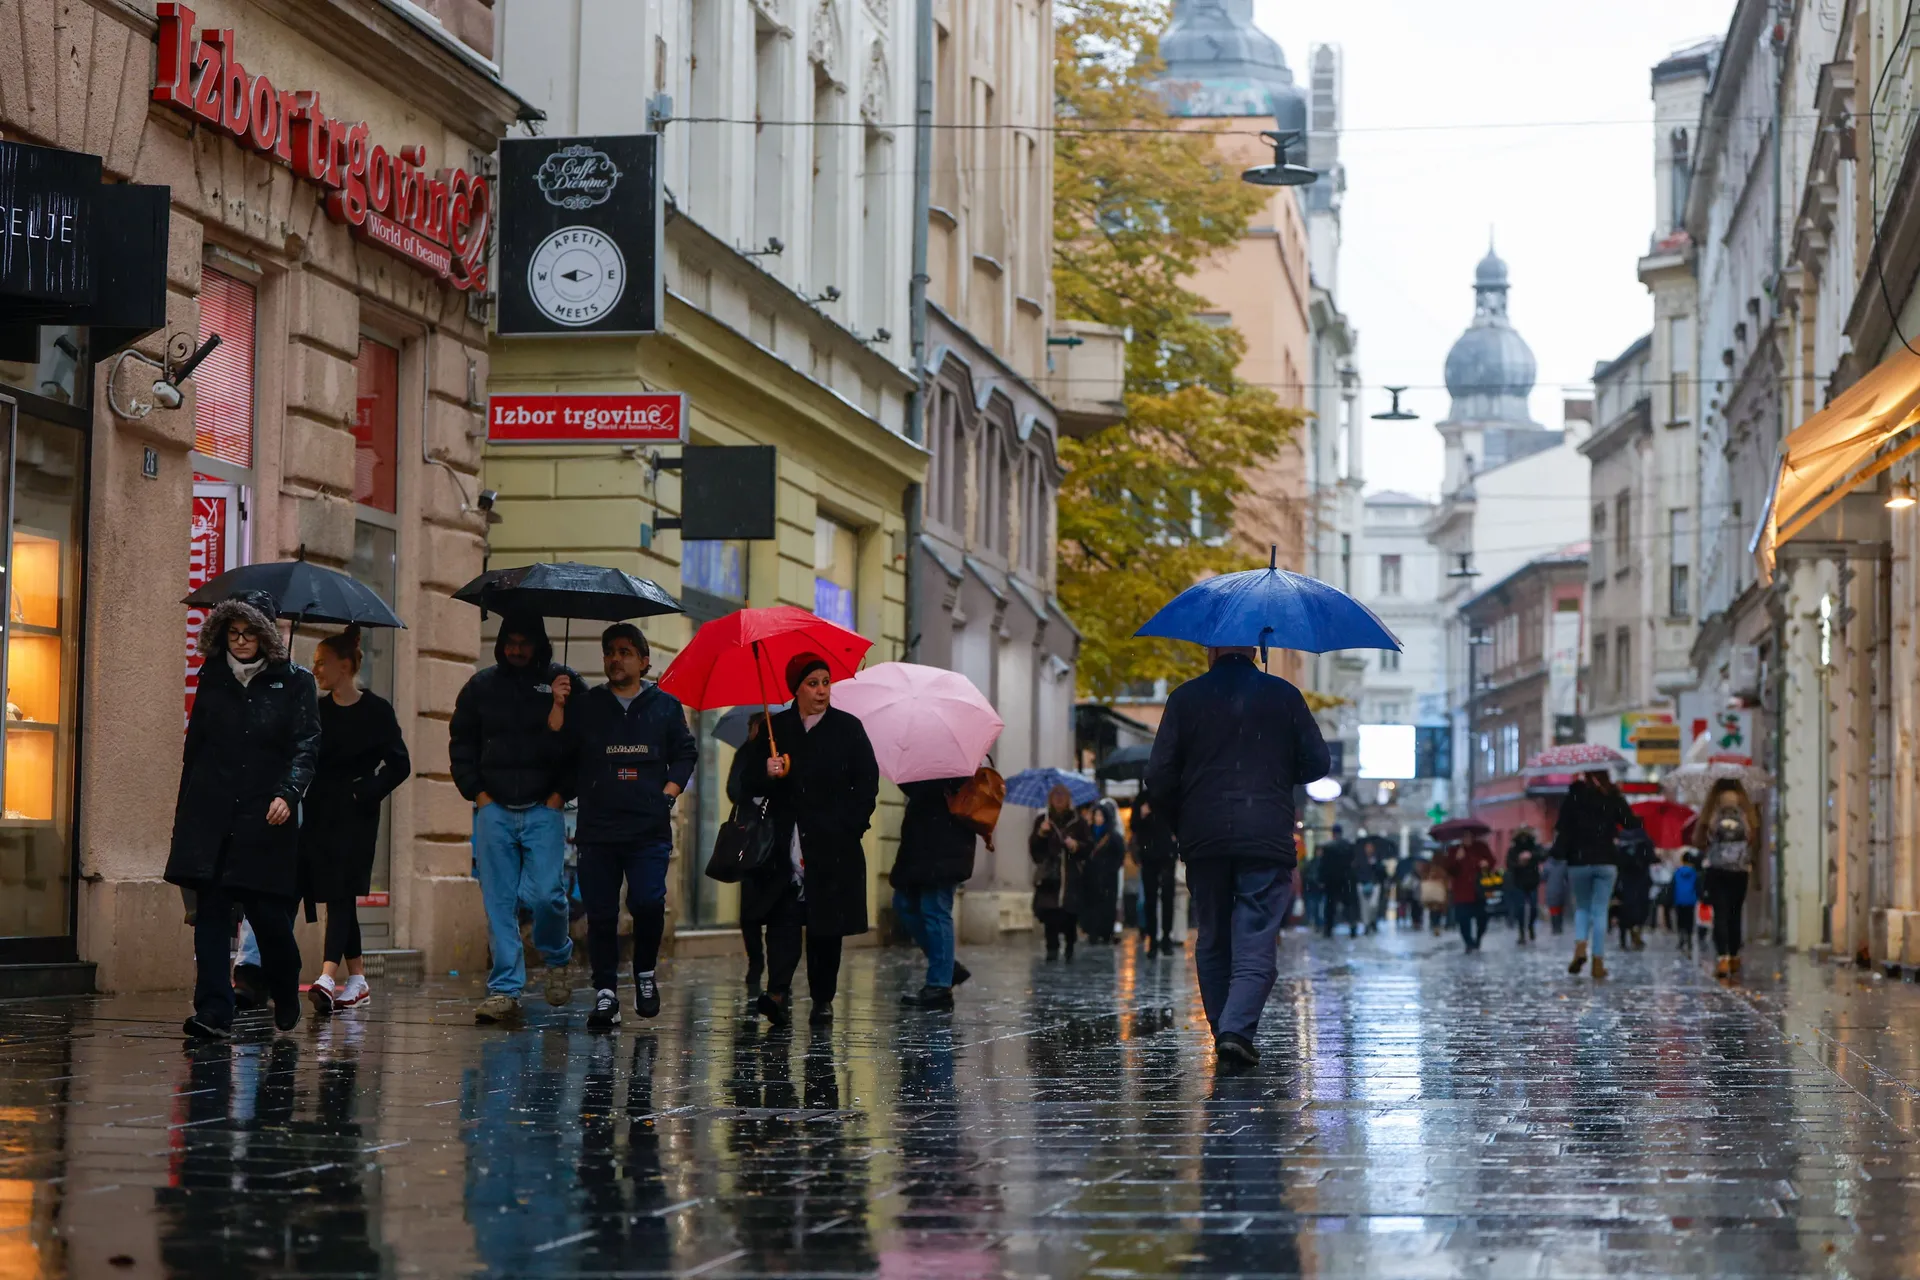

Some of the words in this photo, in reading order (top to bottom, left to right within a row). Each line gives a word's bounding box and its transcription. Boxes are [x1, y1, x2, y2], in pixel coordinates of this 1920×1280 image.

[154, 2, 298, 162] Izbor
[298, 90, 472, 257] trgovine
[547, 174, 609, 190] Diemme
[370, 213, 401, 247] World
[403, 236, 415, 253] of
[416, 239, 450, 274] beauty
[554, 232, 603, 249] APETIT
[537, 271, 548, 281] W
[607, 269, 615, 280] E
[554, 303, 599, 318] MEETS
[494, 406, 556, 424] Izbor
[563, 405, 661, 430] trgovine
